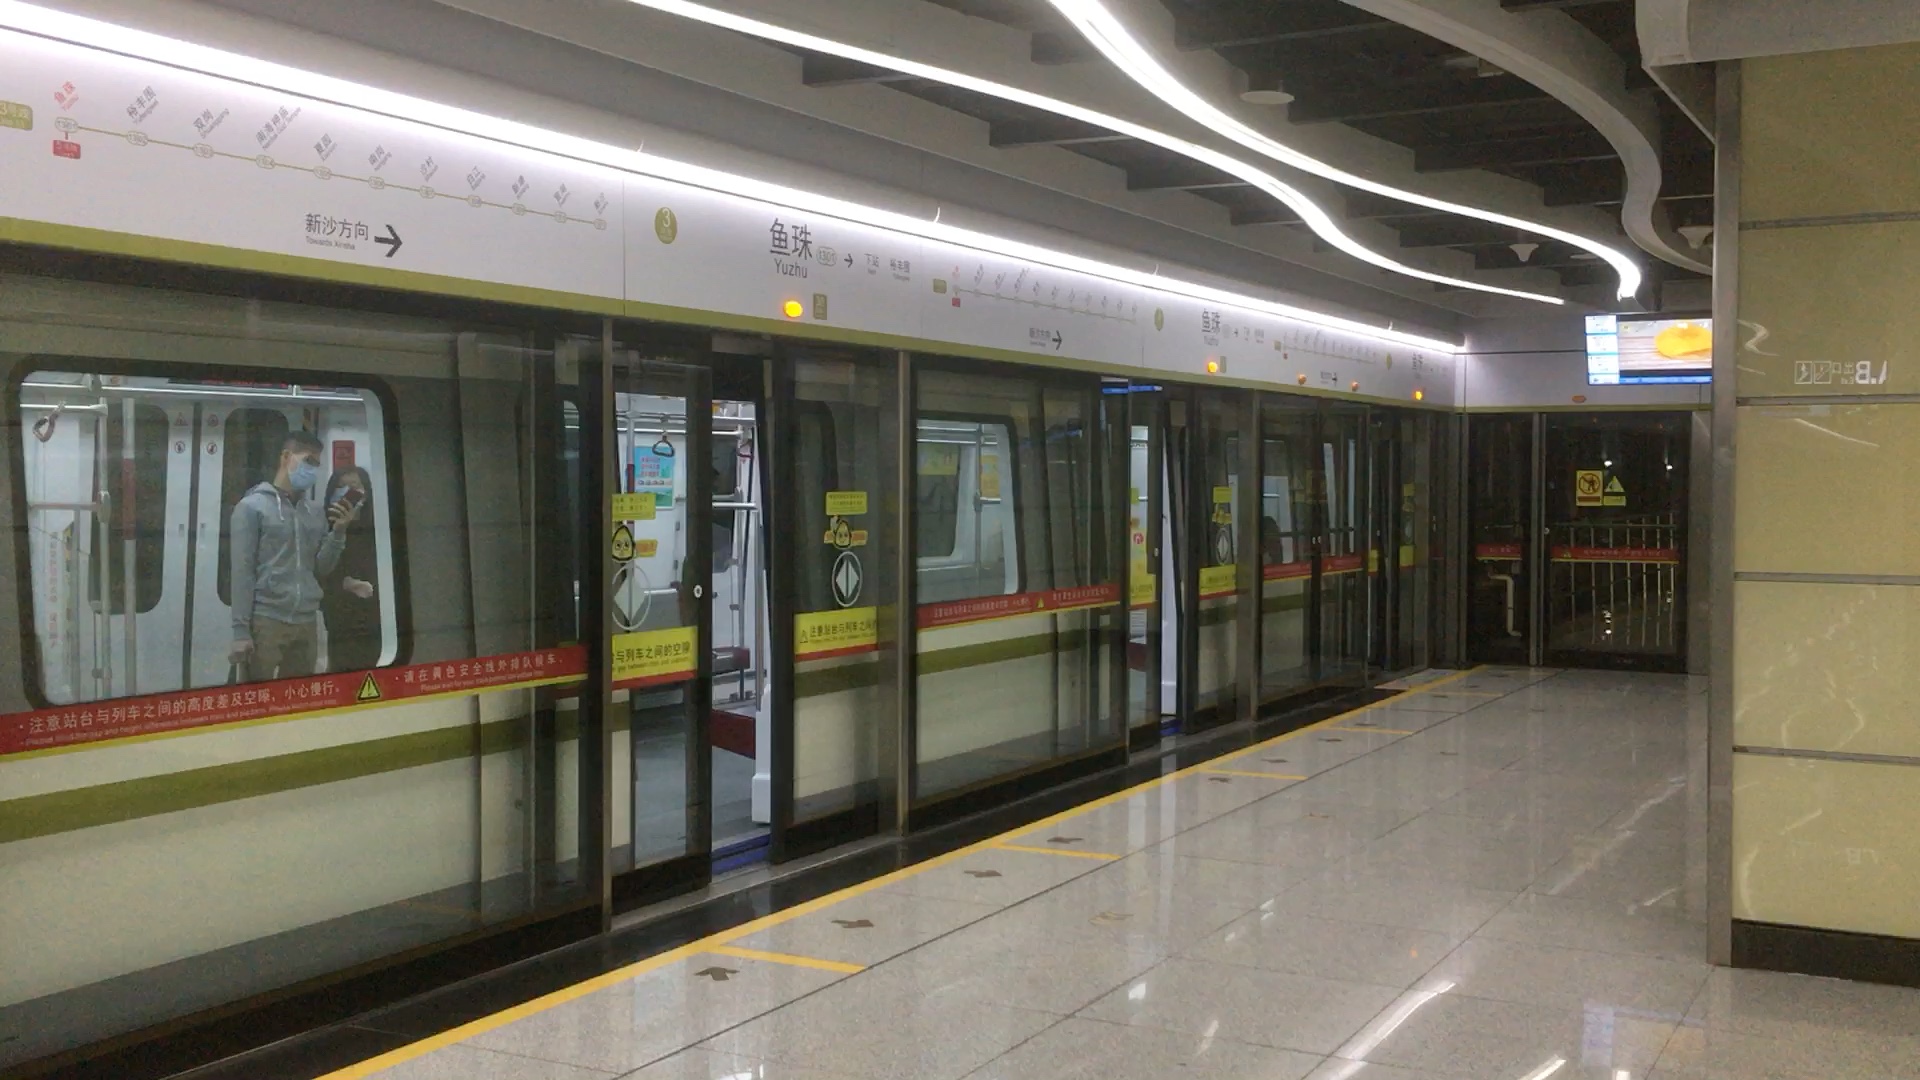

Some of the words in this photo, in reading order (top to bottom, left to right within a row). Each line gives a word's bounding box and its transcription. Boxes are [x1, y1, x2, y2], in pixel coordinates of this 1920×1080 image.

[305, 213, 368, 240] 新沙方向
[662, 208, 671, 228] 3
[770, 218, 813, 260] 鱼珠
[774, 258, 808, 279] Yuzhu
